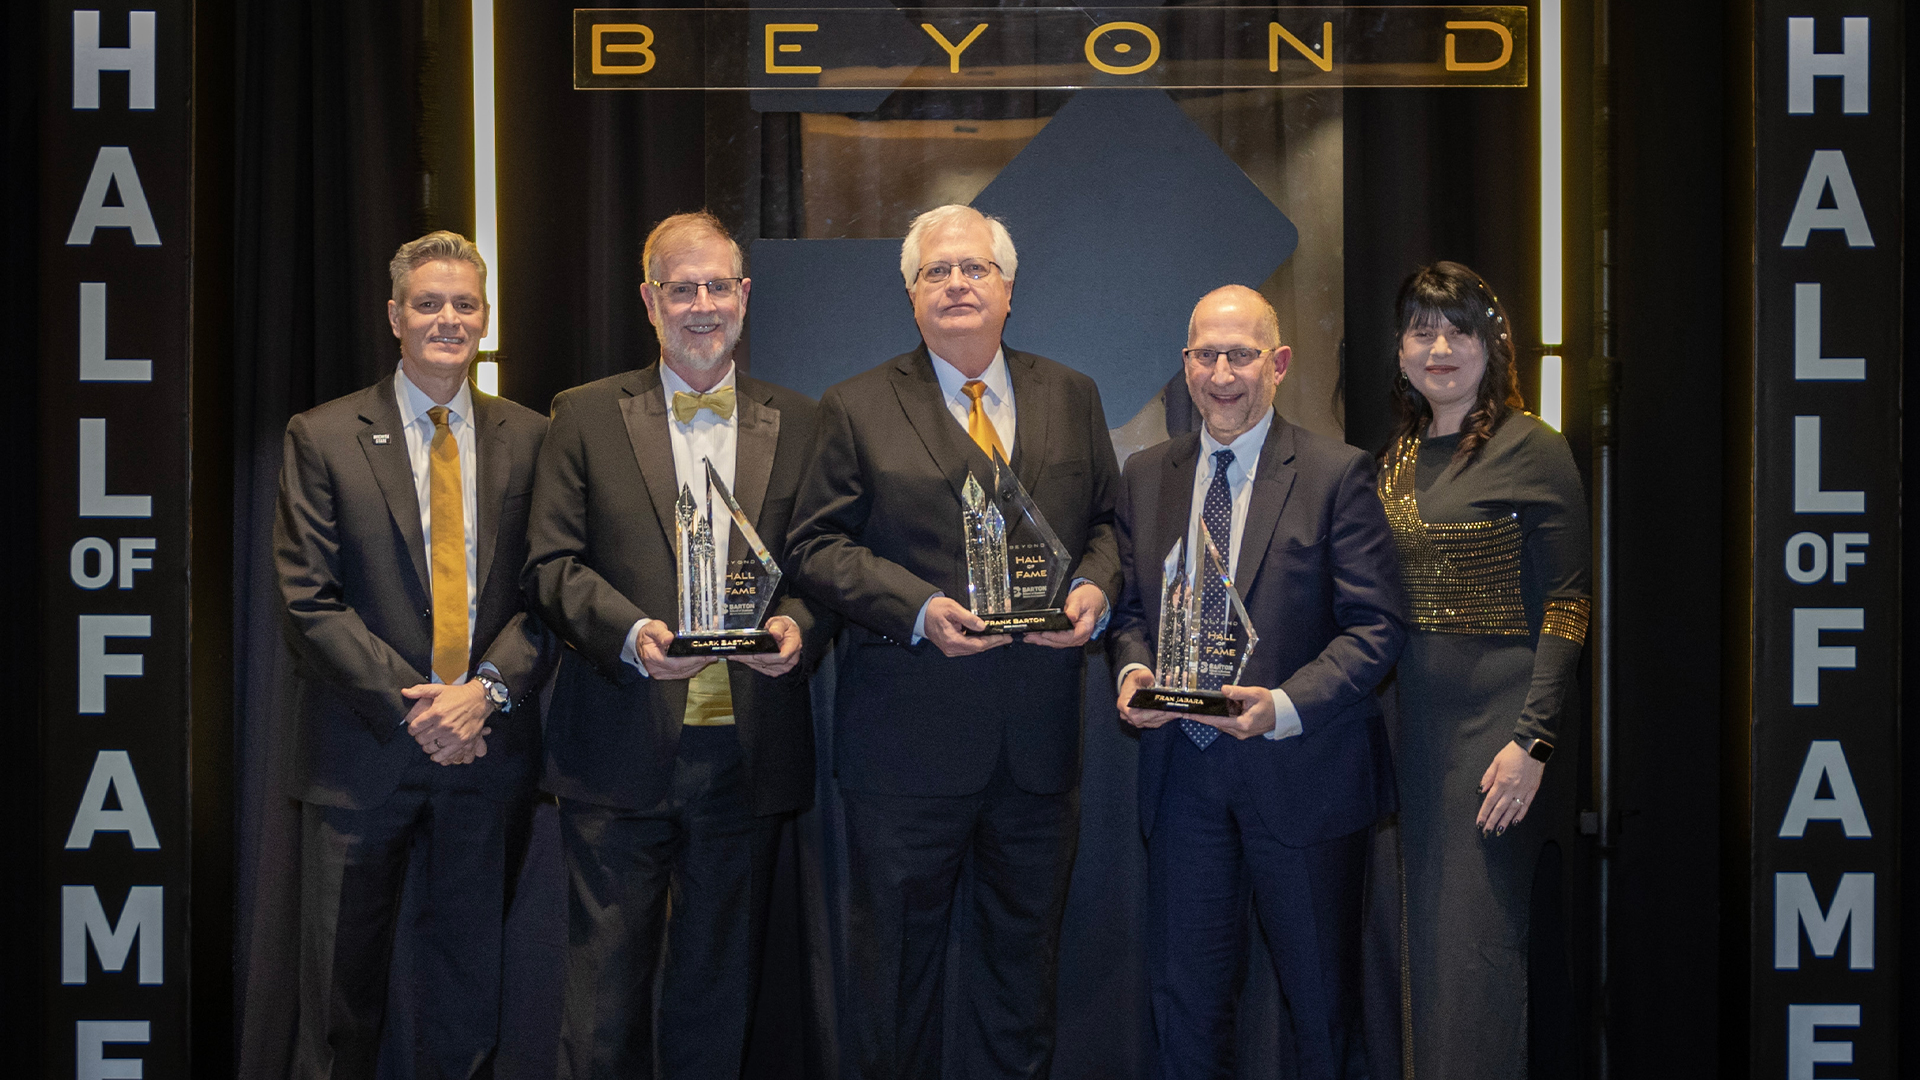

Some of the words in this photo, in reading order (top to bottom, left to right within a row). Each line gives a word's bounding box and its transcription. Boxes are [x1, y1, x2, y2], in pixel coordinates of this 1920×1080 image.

[591, 21, 1514, 76] BEYOND
[66, 10, 163, 517] HALL
[1781, 16, 1876, 514] HALL
[70, 536, 157, 589] OF
[1015, 556, 1045, 564] HALL
[1785, 531, 1870, 584] OF
[725, 571, 755, 580] HALL
[1015, 570, 1047, 578] FAME
[724, 586, 756, 595] FAME
[1206, 647, 1236, 656] FAME
[1208, 632, 1236, 641] HALL
[1154, 694, 1175, 702] FRAN
[62, 614, 164, 1080] FAME
[1774, 607, 1876, 1080] FAME
